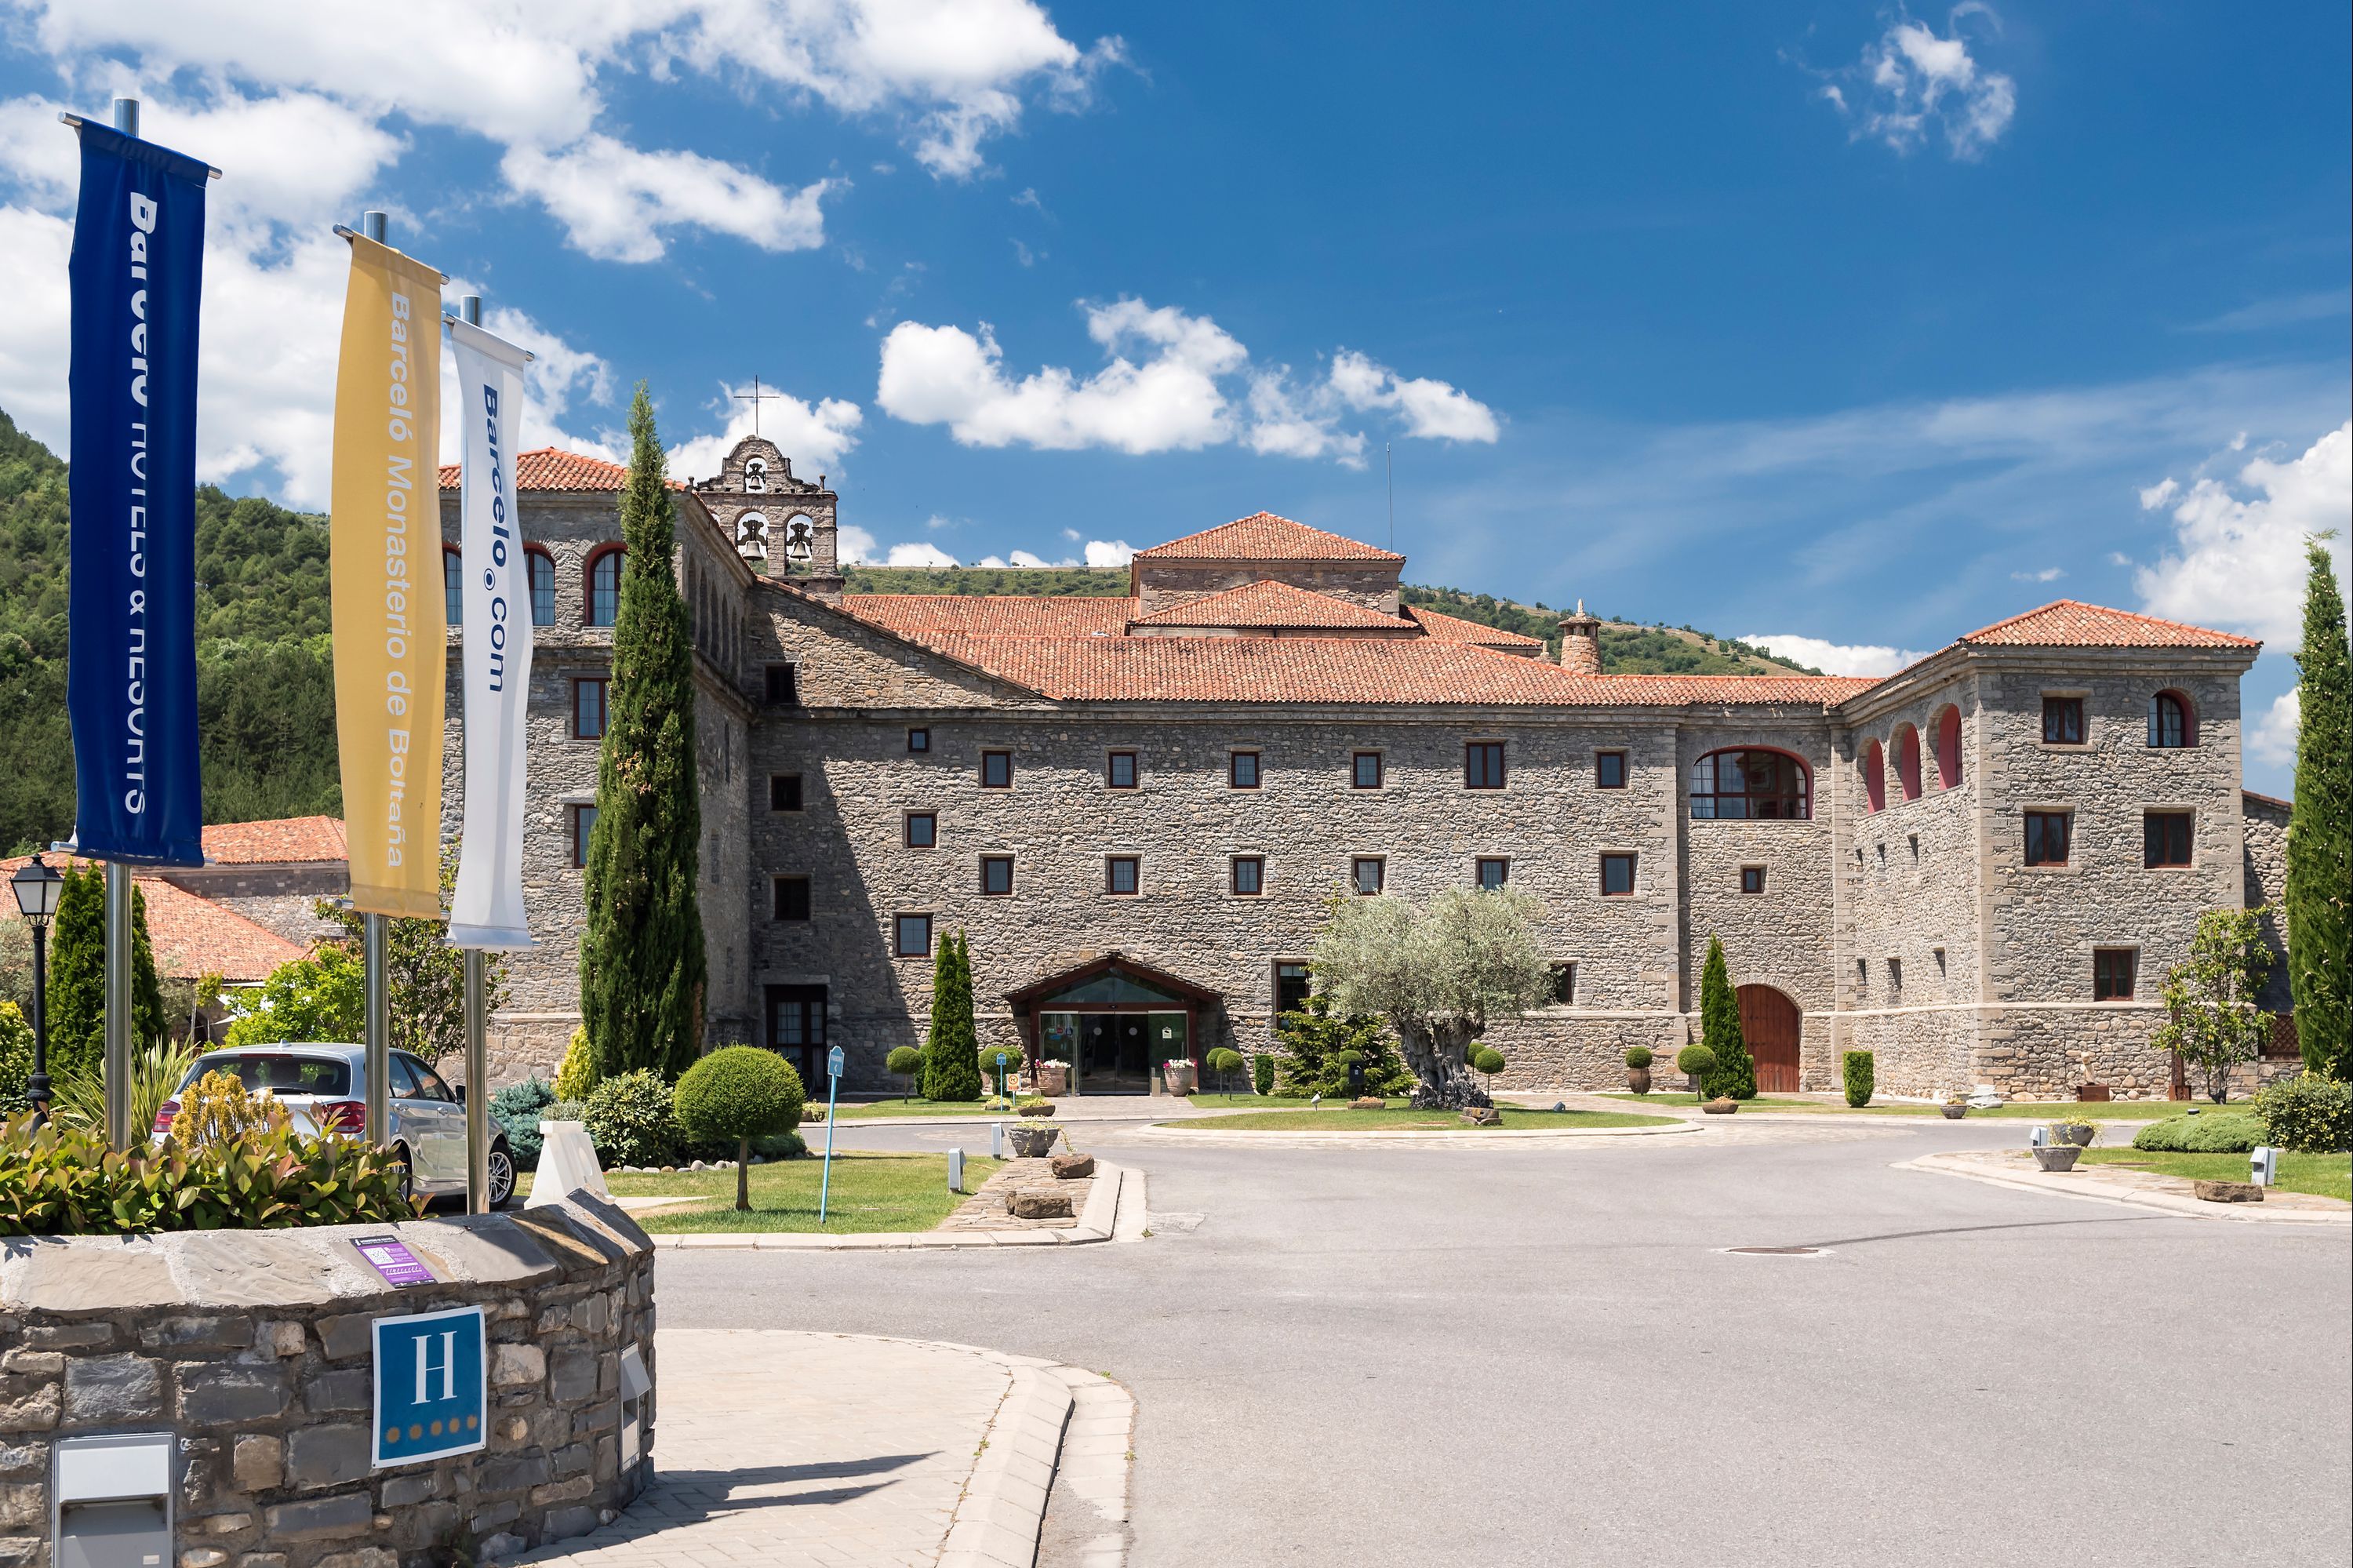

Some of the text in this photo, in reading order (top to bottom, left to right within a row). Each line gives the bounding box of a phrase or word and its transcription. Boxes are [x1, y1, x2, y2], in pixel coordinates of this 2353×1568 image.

[129, 590, 146, 616] &
[385, 291, 414, 868] Barceló Monasterio de Boltaña
[410, 1330, 458, 1406] H
